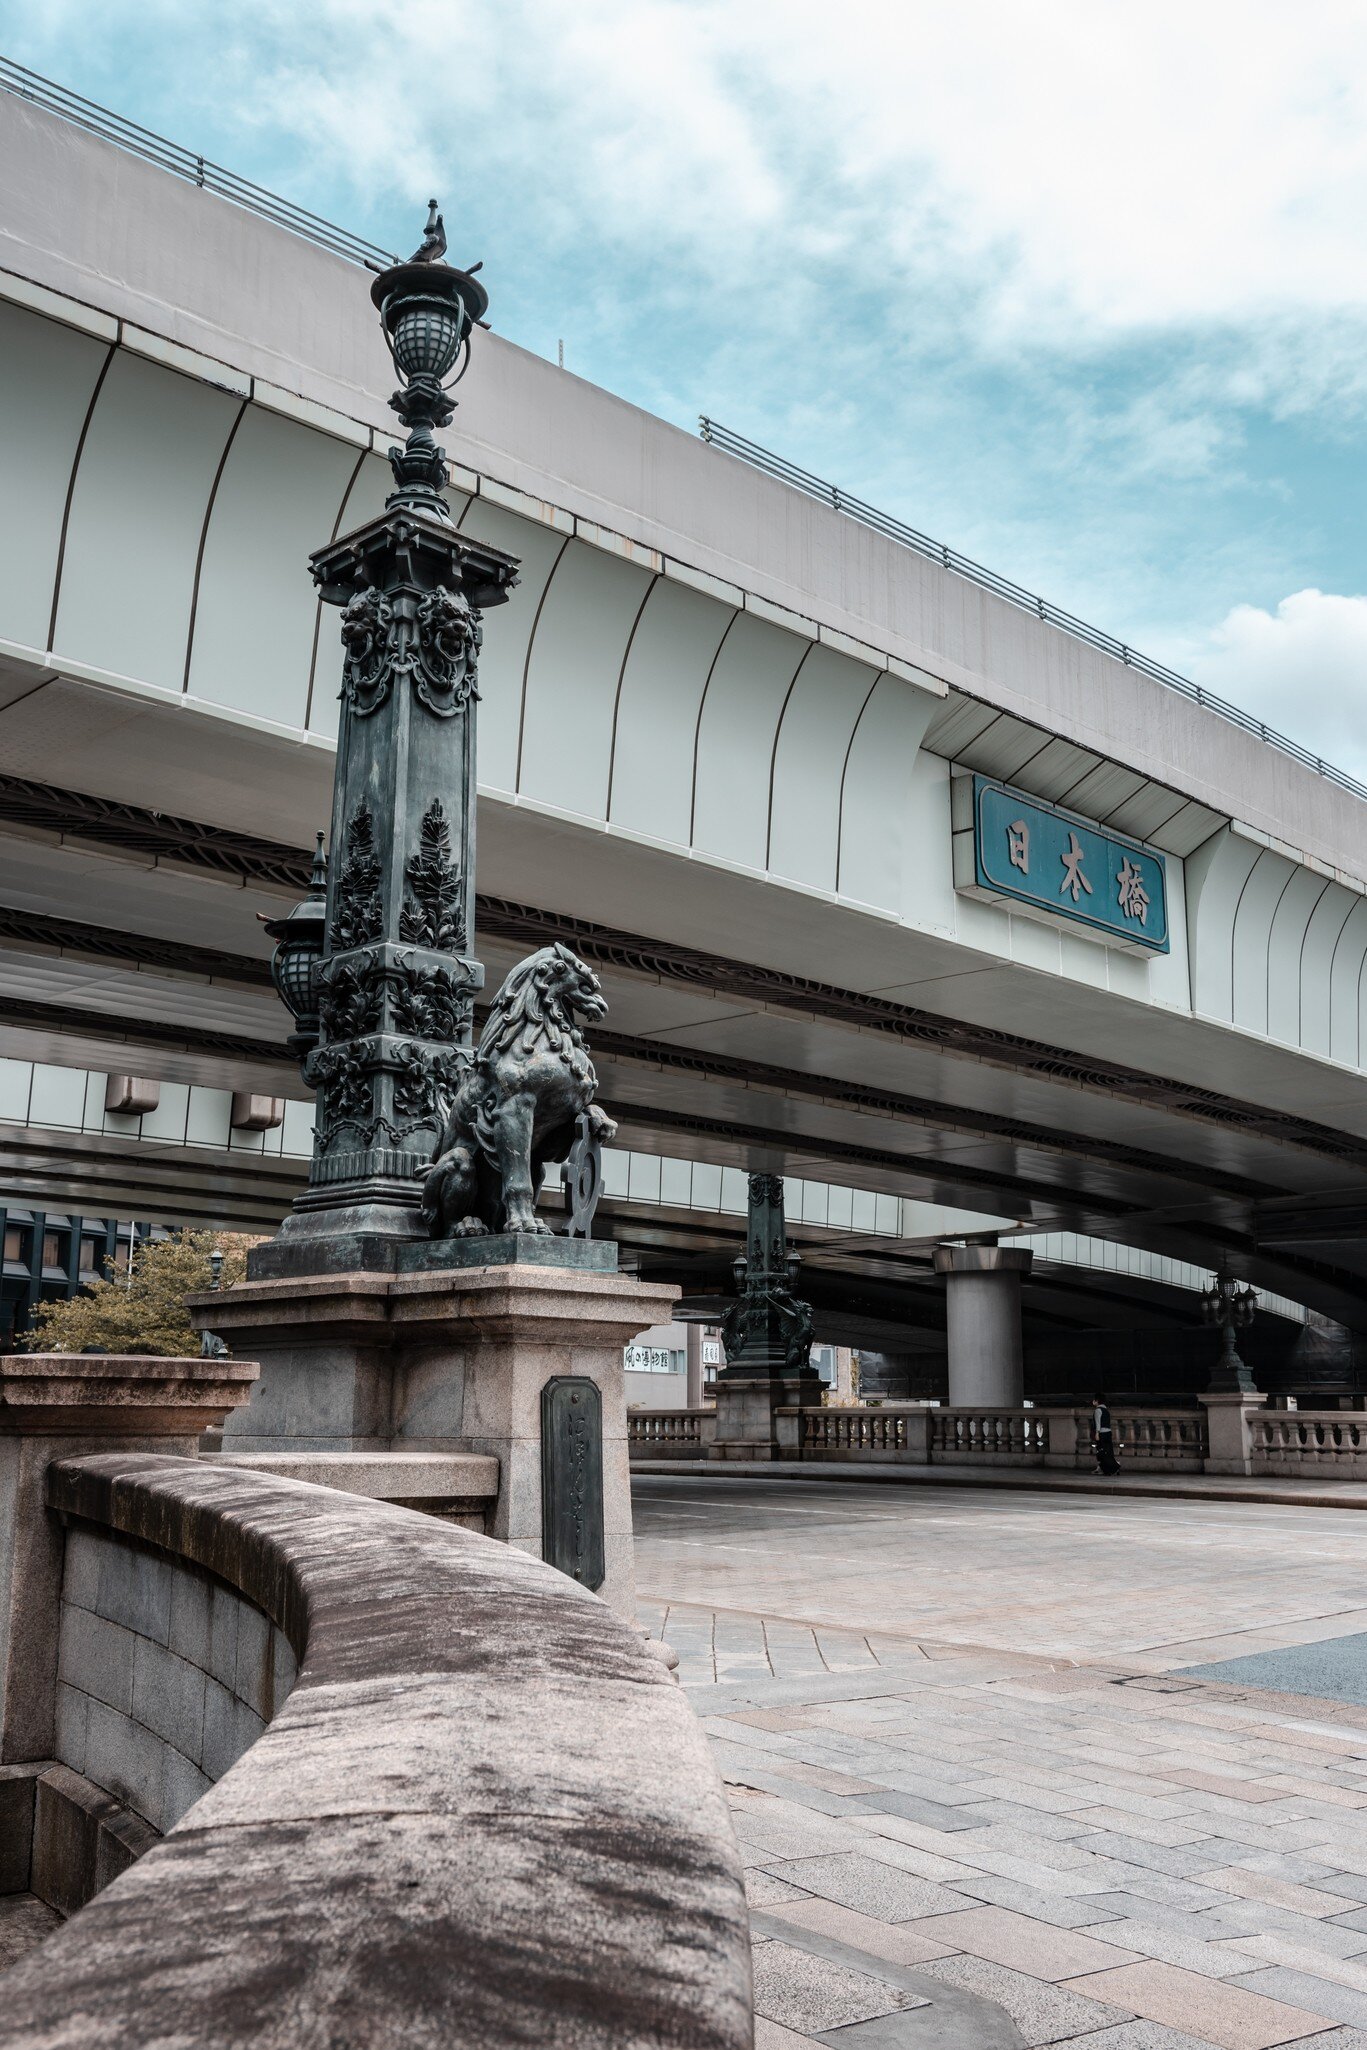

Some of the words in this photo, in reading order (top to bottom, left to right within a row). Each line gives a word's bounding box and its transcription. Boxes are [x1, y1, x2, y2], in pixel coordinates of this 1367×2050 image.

[1006, 819, 1150, 926] 日本橋
[624, 1346, 668, 1367] 凧の博物館
